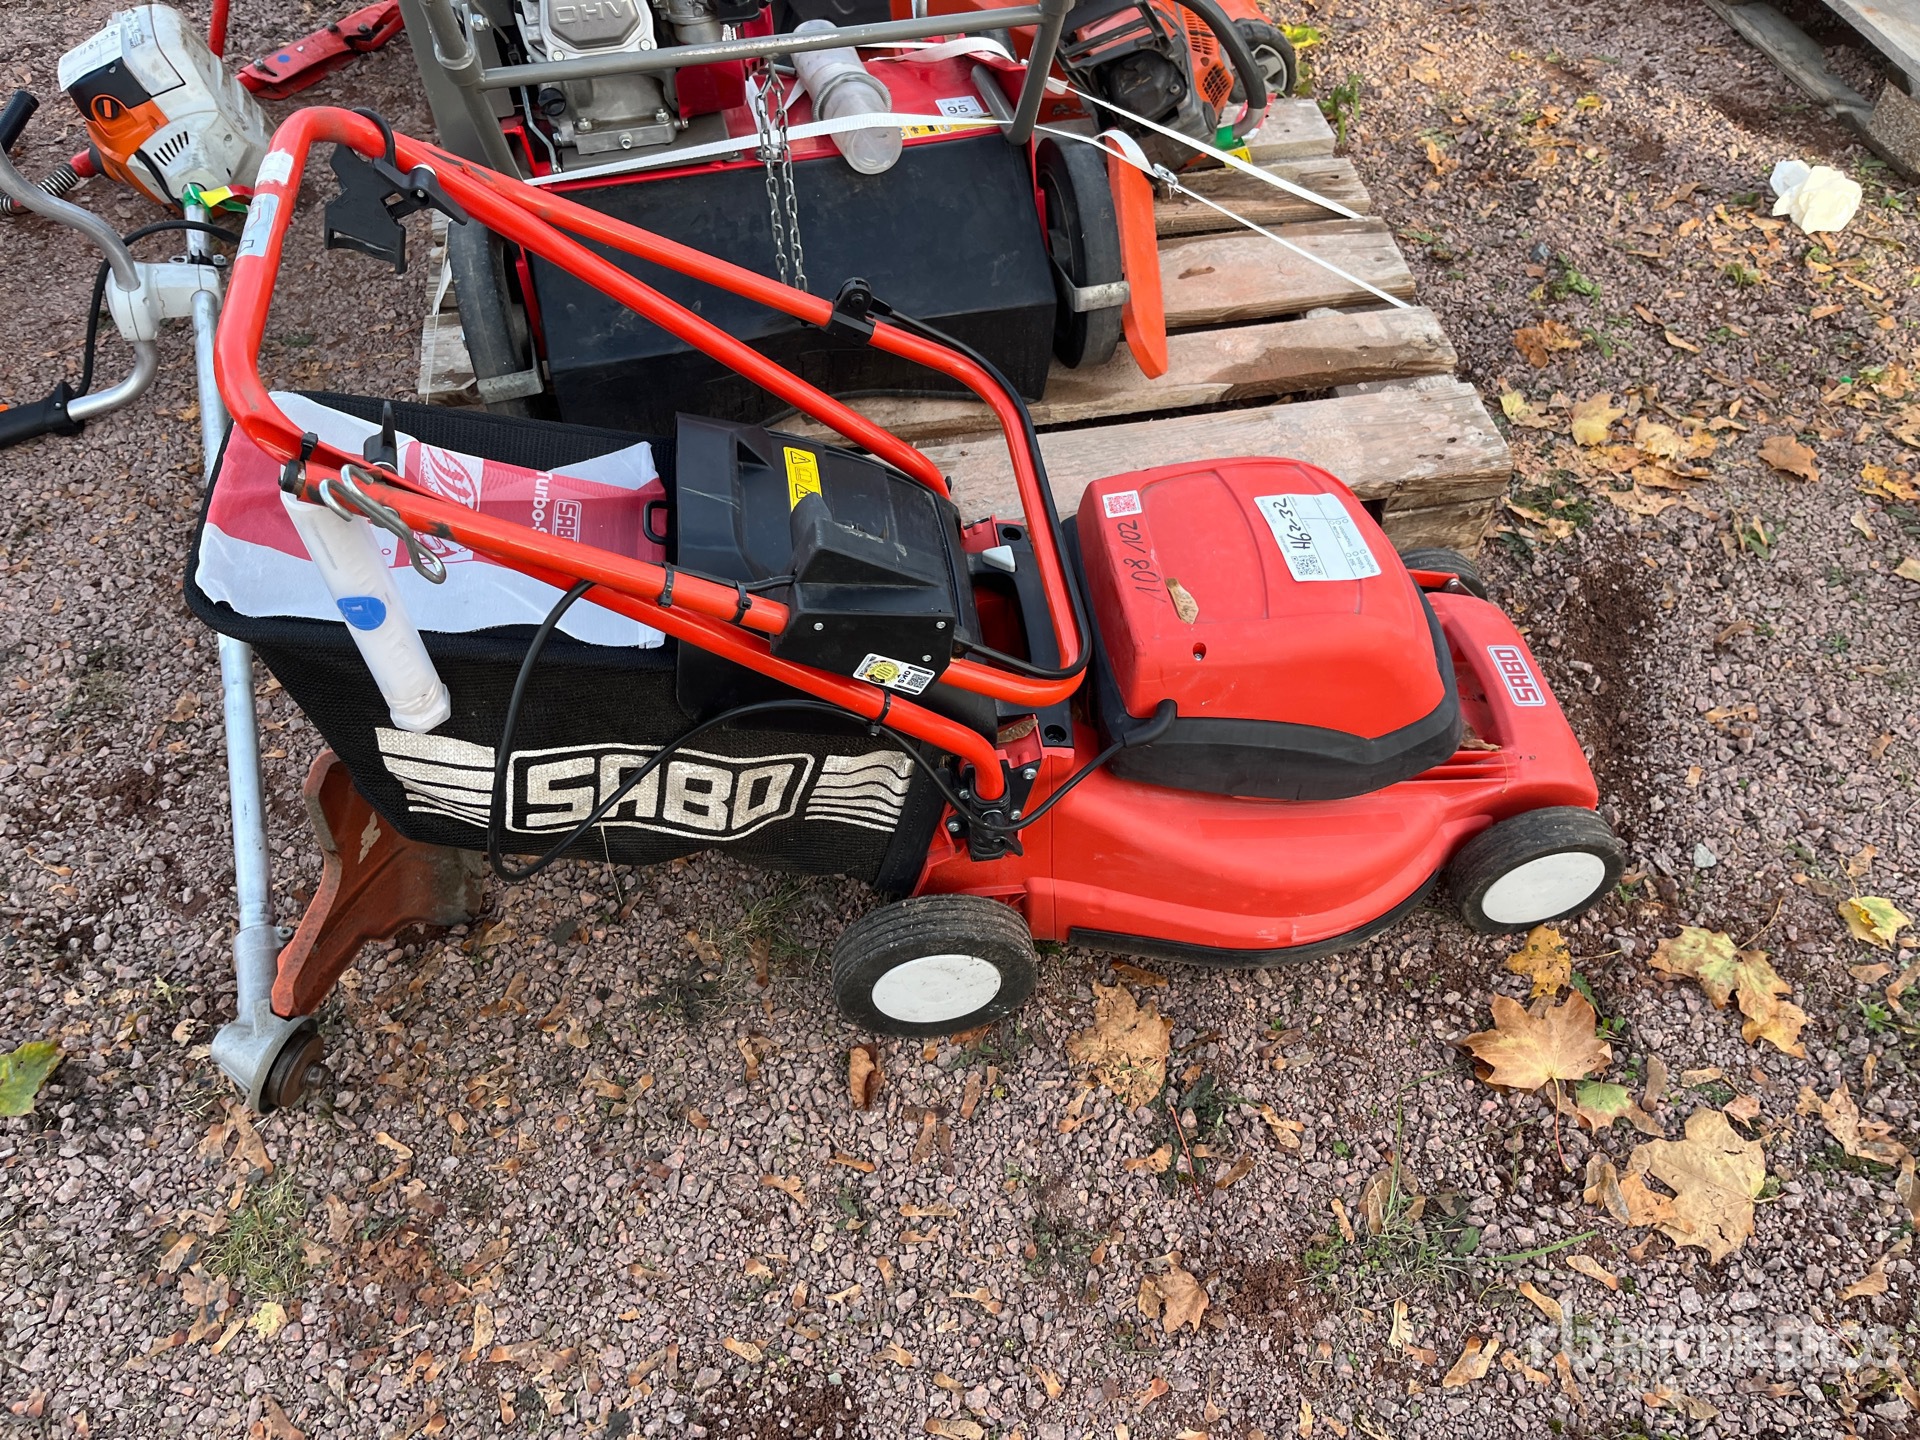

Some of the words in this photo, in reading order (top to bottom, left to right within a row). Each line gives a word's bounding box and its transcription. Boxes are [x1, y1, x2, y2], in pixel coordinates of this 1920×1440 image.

[556, 0, 627, 23] OHV
[947, 104, 969, 114] 95
[555, 501, 578, 542] SAB
[1493, 649, 1540, 702] SABO
[526, 754, 796, 831] SABO
